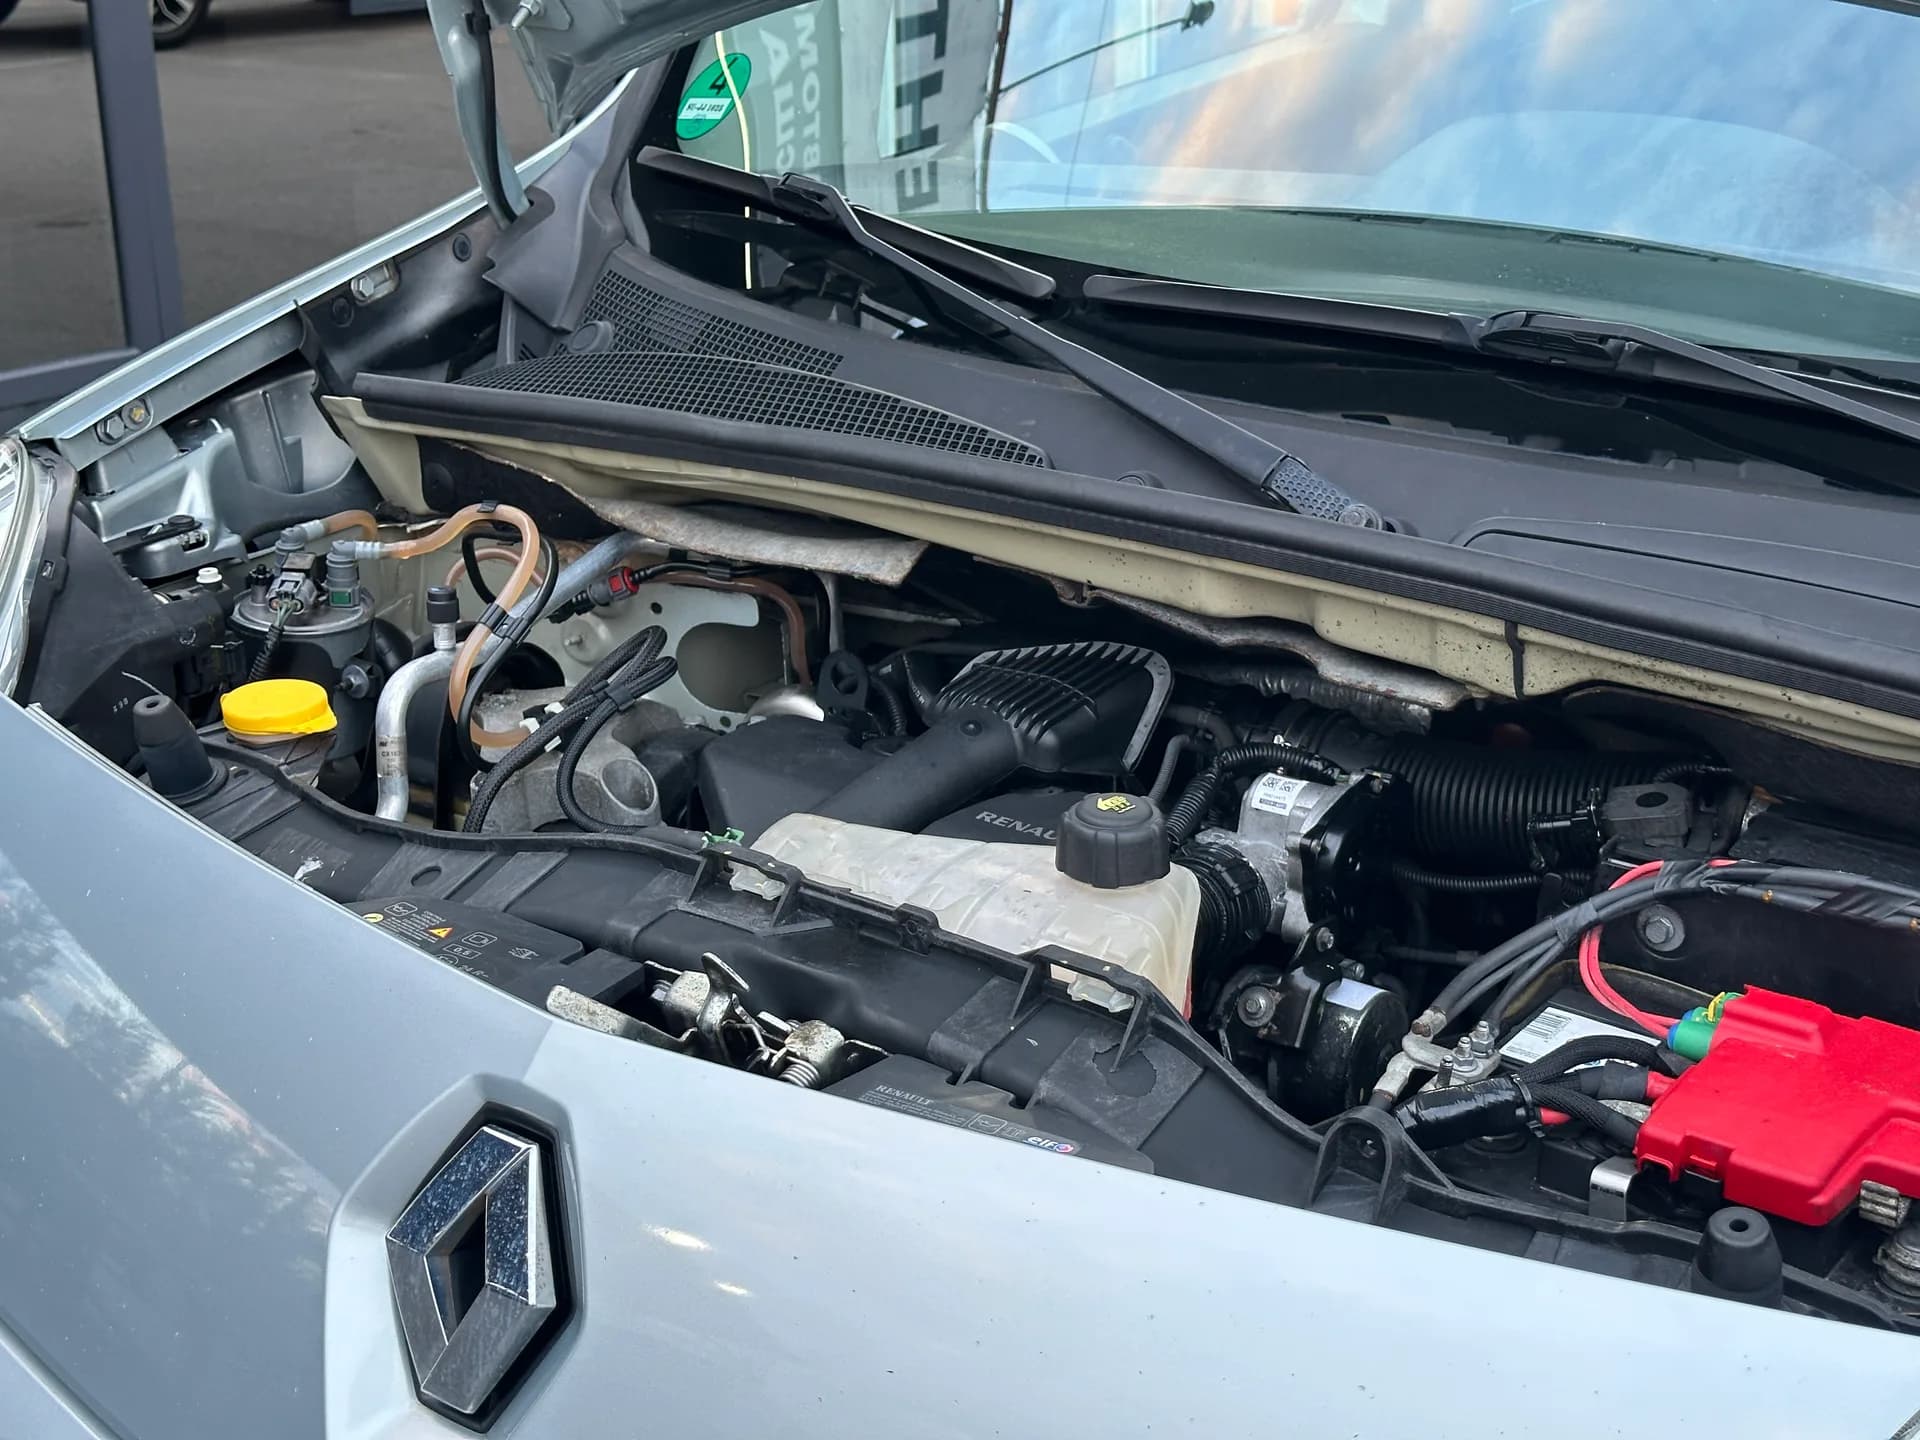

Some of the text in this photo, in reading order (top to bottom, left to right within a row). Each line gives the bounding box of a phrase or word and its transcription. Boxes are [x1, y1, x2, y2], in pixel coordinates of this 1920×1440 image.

[708, 57, 739, 95] 4
[975, 811, 1058, 840] RENAU
[876, 1084, 934, 1105] RENAULT
